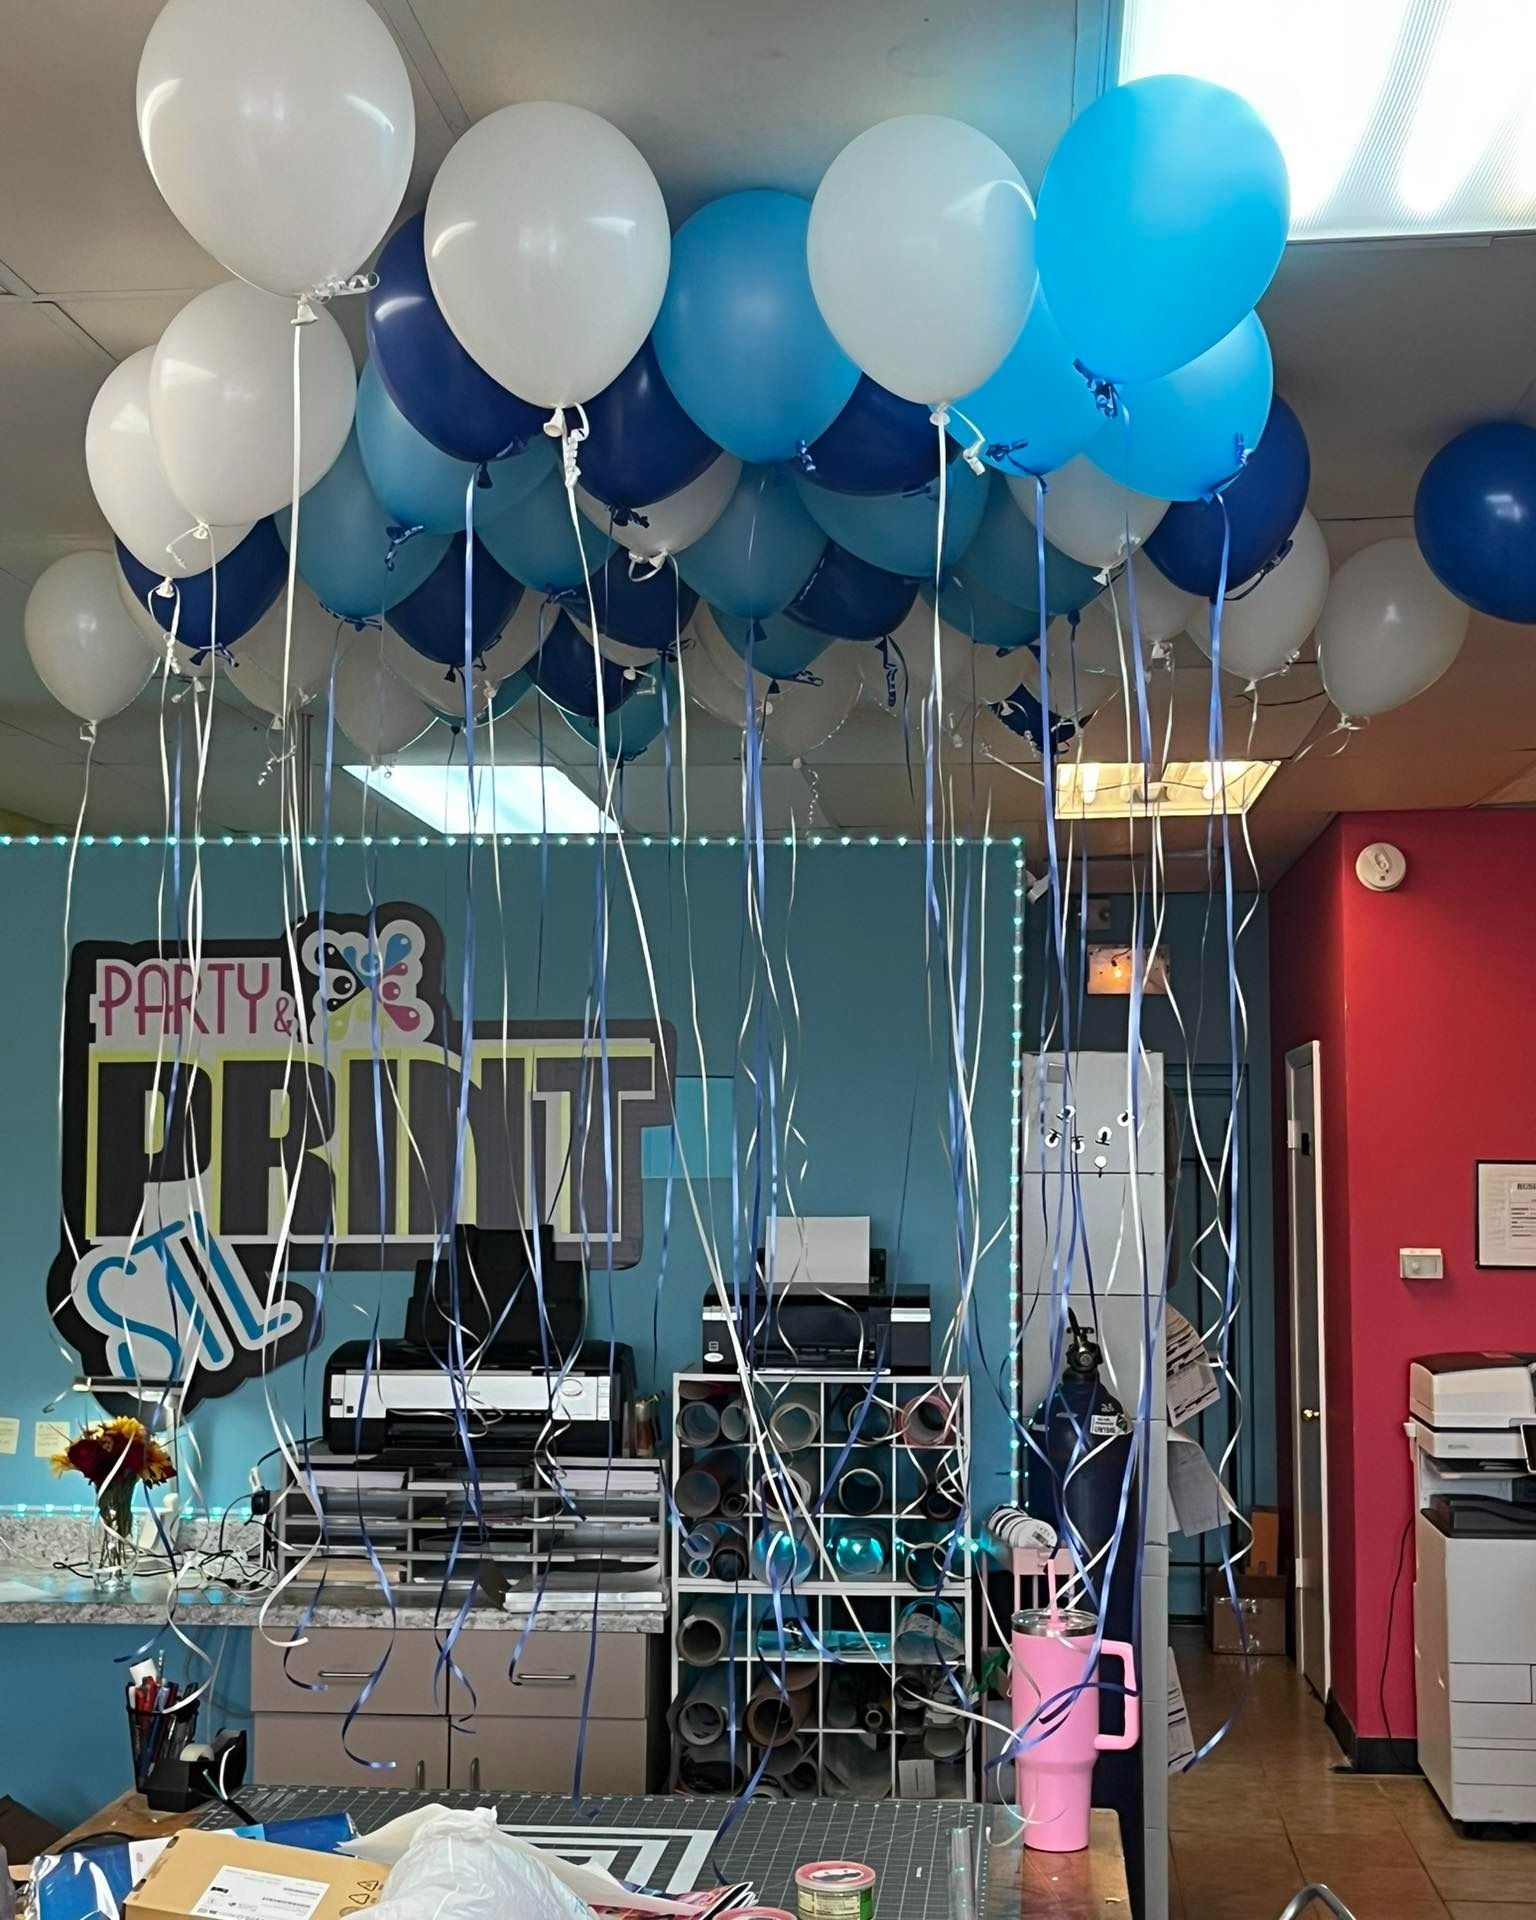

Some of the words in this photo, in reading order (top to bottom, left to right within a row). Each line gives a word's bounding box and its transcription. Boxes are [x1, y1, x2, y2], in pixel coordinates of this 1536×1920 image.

[98, 962, 272, 1037] PARTY
[273, 996, 294, 1035] &
[86, 1050, 656, 1236] PRINT
[86, 1210, 294, 1378] STL
